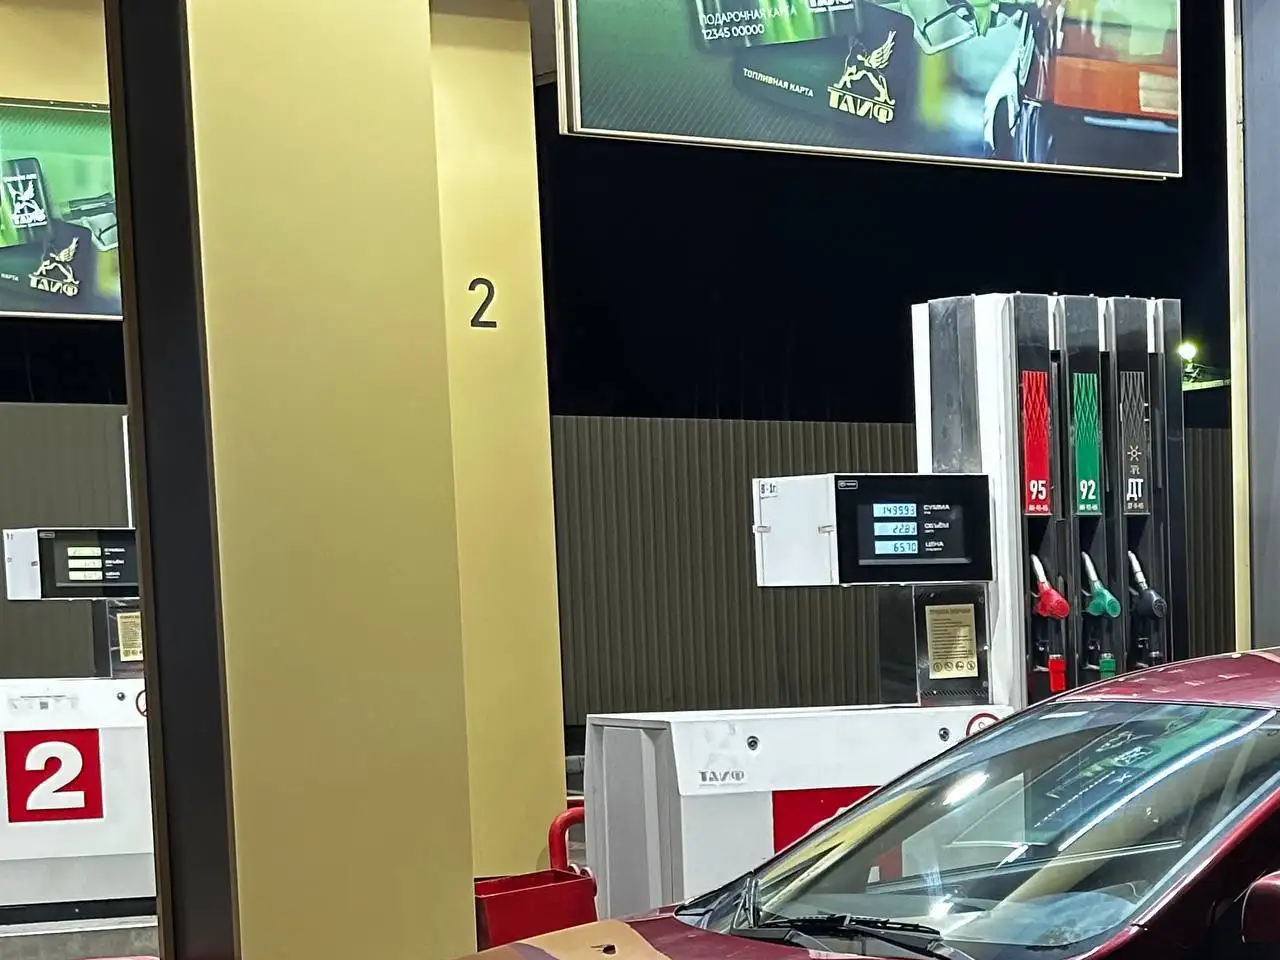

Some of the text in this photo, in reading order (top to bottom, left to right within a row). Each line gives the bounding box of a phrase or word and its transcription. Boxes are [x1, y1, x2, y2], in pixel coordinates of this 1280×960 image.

[768, 5, 797, 18] КАА
[704, 24, 764, 39] 12345 00000
[743, 68, 814, 97] ТОПЛИВНАЯ КАРТА
[828, 87, 895, 123] ТАИФ
[468, 277, 497, 328] 2
[1029, 480, 1046, 500] 95
[1080, 480, 1096, 500] 92
[1127, 478, 1144, 501] ДТ
[25, 741, 85, 811] 2
